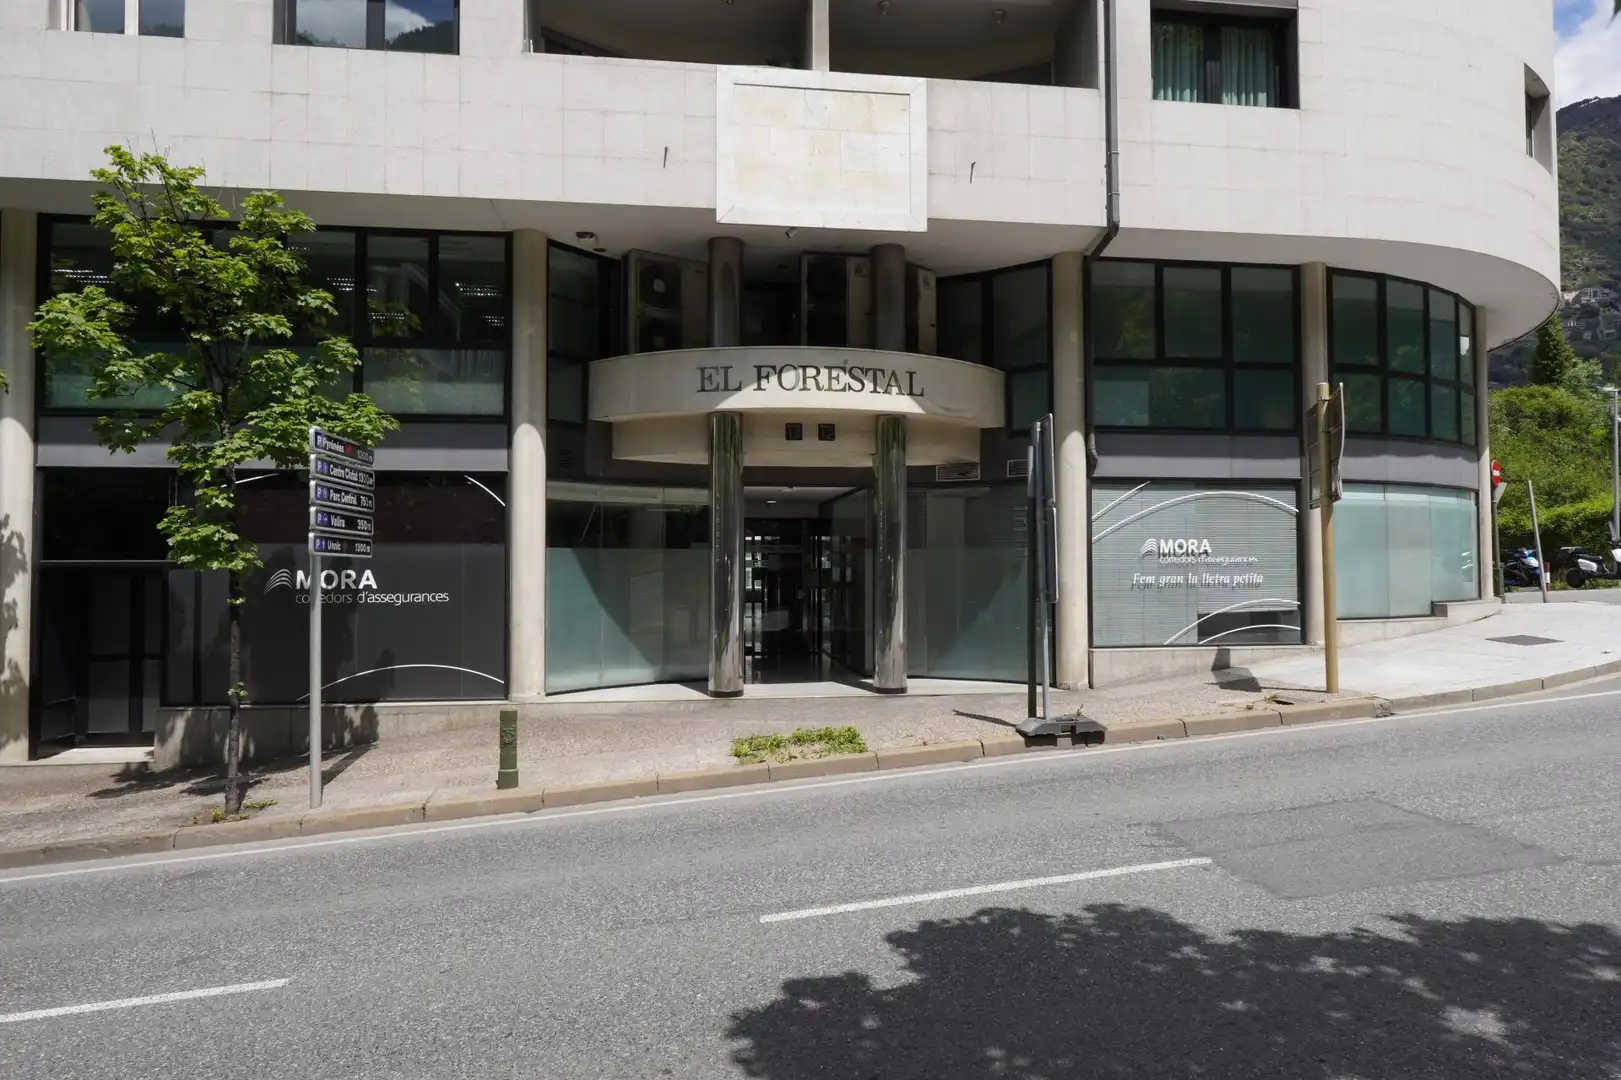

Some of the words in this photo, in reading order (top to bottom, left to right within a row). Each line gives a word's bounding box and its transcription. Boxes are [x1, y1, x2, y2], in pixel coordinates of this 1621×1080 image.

[696, 366, 742, 393] EL
[753, 364, 924, 397] FORESTAL
[330, 489, 340, 502] Parc
[341, 492, 357, 505] Central
[331, 515, 345, 528] Valira
[357, 519, 367, 530] 350
[355, 543, 366, 553] 1300
[1160, 539, 1212, 553] MORA
[296, 569, 378, 590] MORA
[1133, 573, 1155, 584] Fem
[1160, 575, 1183, 587] gran
[1188, 573, 1198, 584] la
[1202, 573, 1230, 584] lletra
[1233, 572, 1264, 586] petita
[296, 592, 352, 604] coedors
[357, 591, 450, 606] d'assegurances
